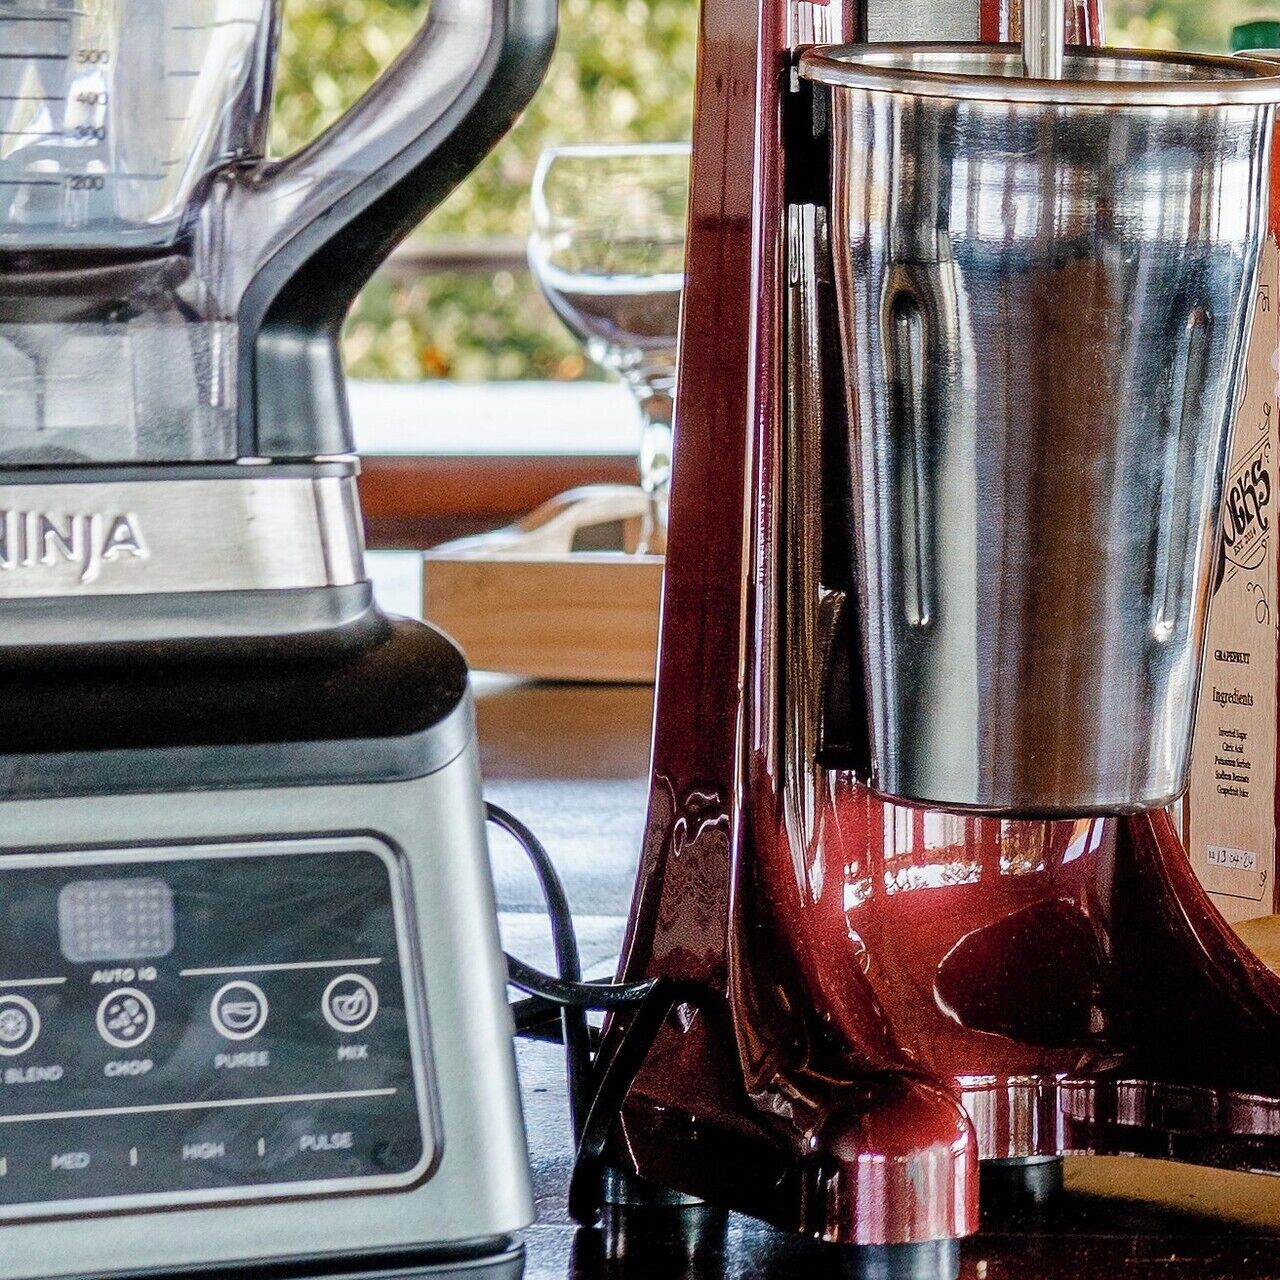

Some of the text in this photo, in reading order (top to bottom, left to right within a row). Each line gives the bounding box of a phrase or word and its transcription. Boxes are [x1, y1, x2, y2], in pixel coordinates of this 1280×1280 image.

[78, 49, 110, 64] 500
[76, 91, 109, 106] 400
[1212, 686, 1254, 709] Ingredients
[90, 967, 136, 984] AUTO
[214, 1050, 269, 1069] PUREE
[337, 1044, 369, 1061] MIX
[4, 1064, 64, 1085] BLEND
[103, 1058, 154, 1078] CHOP
[182, 1141, 226, 1161] HIGH
[299, 1131, 353, 1152] PULSE
[51, 1150, 91, 1171] MED
